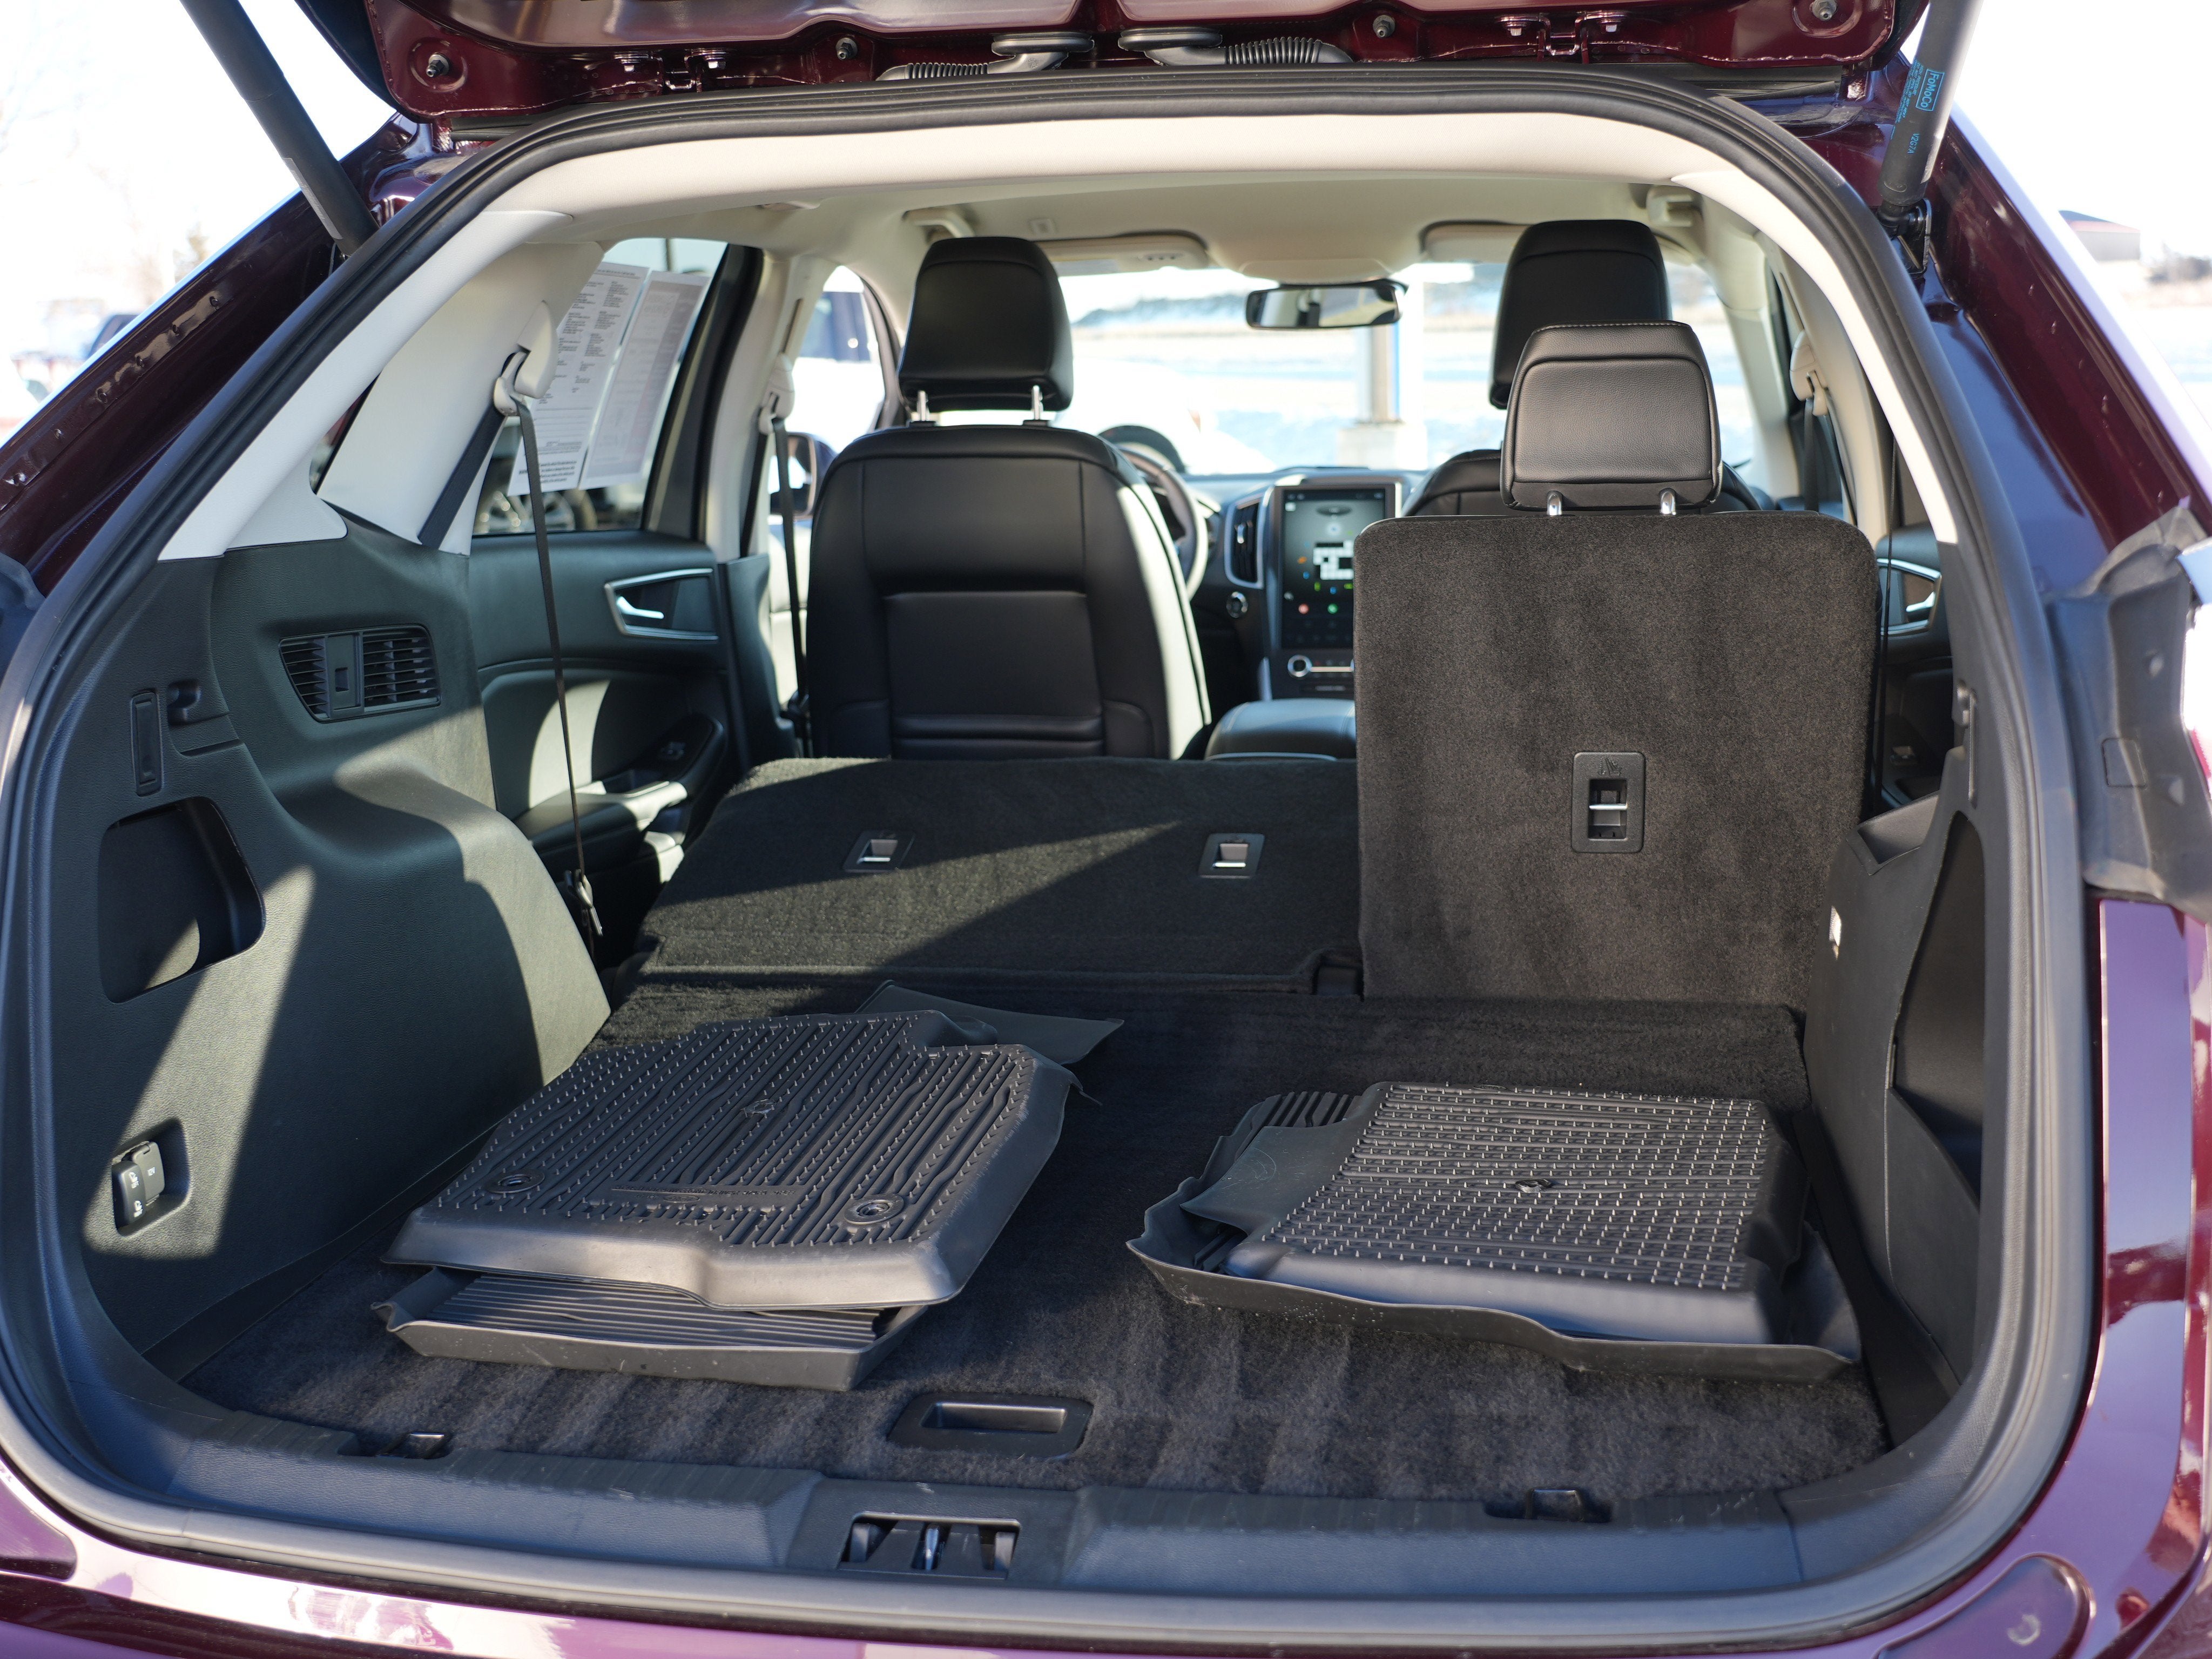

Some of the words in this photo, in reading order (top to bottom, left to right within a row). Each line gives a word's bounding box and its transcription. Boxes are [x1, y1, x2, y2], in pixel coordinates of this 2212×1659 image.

[1912, 76, 1921, 96] PRESSURE
[1920, 72, 1939, 108] FoMoCo
[1907, 133, 1920, 154] V2G7A
